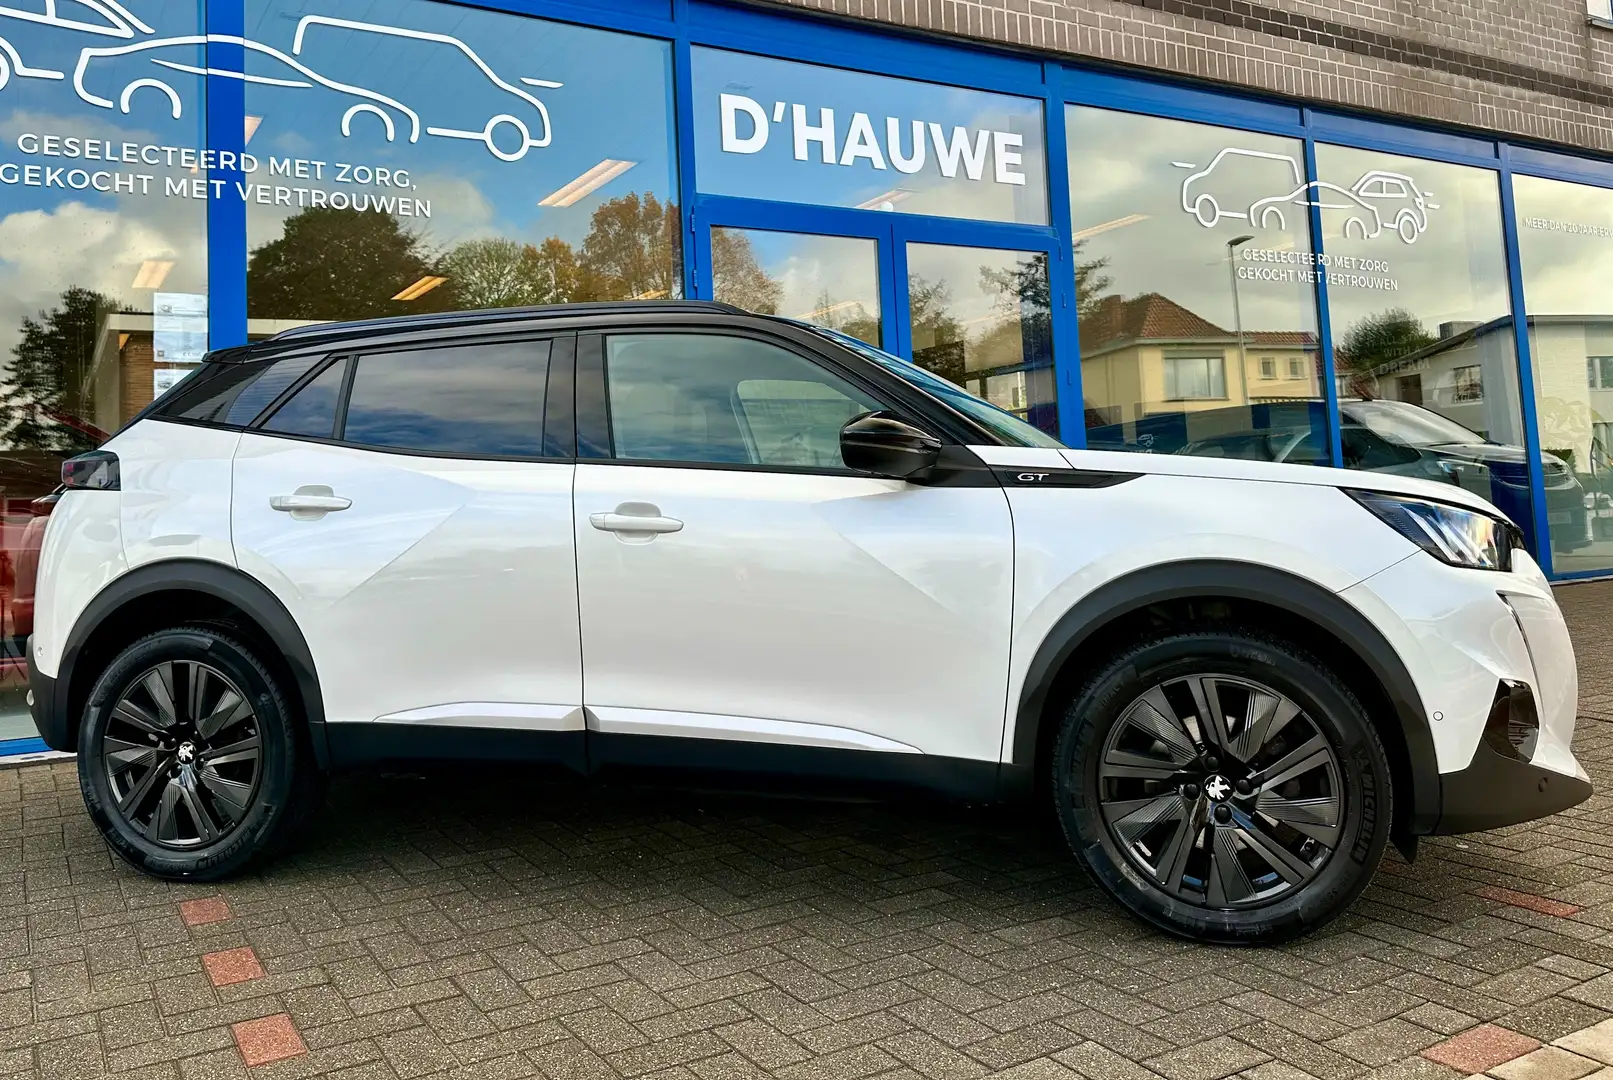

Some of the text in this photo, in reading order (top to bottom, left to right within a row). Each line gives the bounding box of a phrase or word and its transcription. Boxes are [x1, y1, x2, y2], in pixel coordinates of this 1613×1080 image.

[719, 93, 1026, 186] D'HAUWE
[17, 133, 417, 191] GESELECTEERD MET ZORG,
[0, 163, 432, 219] GEKOCHT MET VERTROUWEN
[1525, 217, 1548, 229] MEER
[1549, 220, 1567, 231] DAN
[1238, 266, 1294, 282] GEKOCHT
[1297, 270, 1323, 283] MET
[1243, 249, 1389, 272] GESELECTEERD MET ZORG
[1017, 472, 1049, 482] GT
[1354, 773, 1376, 863] MICHELIN
